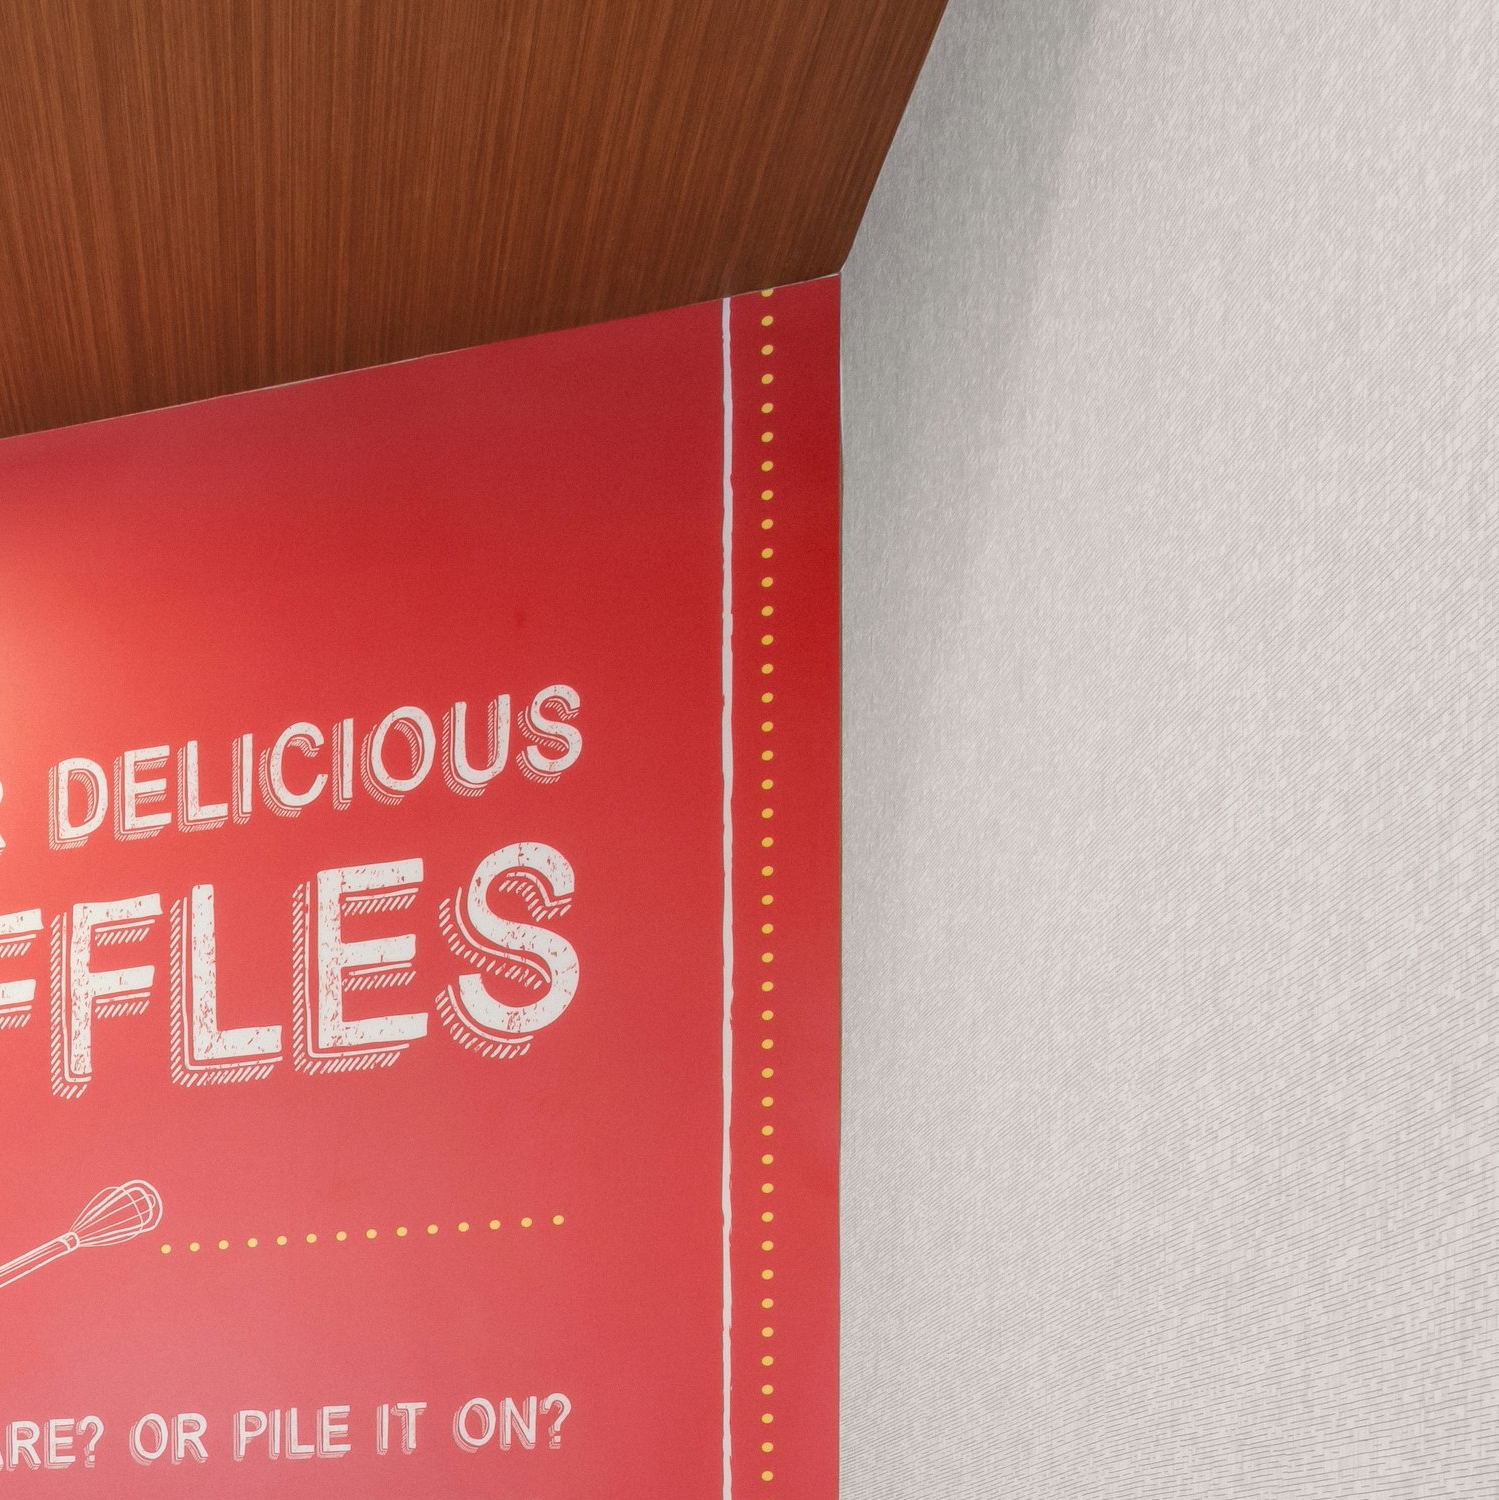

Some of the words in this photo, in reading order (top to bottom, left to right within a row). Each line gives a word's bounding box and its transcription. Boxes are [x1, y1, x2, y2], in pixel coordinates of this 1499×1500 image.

[47, 684, 582, 852] DELICIOUS
[129, 1413, 209, 1464] OR
[233, 1406, 352, 1460] PILE
[376, 1402, 428, 1455] IT
[453, 1393, 574, 1452] ON?
